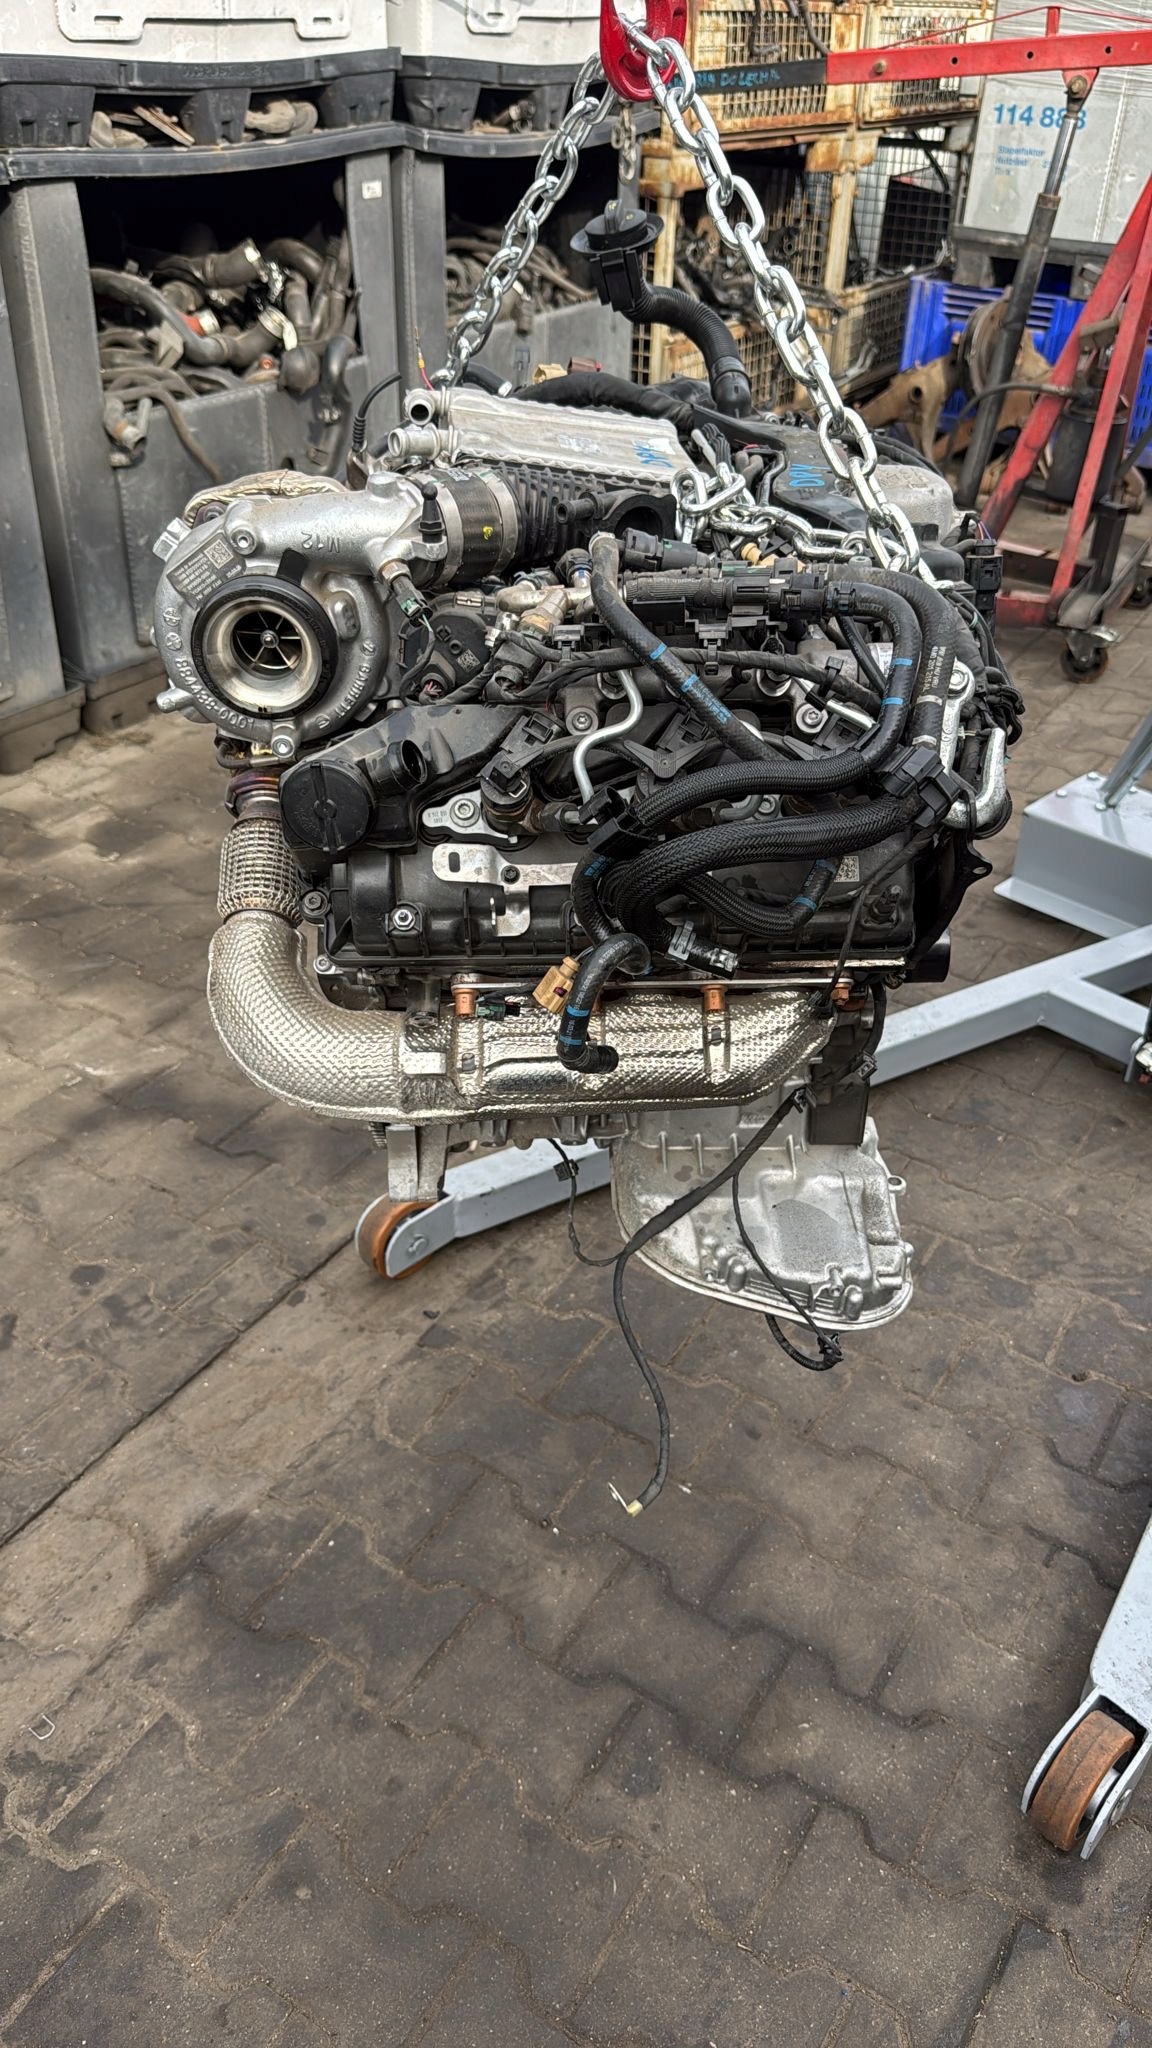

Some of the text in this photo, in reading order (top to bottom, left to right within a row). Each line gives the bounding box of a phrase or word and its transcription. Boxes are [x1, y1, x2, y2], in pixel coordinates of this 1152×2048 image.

[994, 103, 1033, 127] 114
[301, 531, 341, 554] M12
[334, 663, 372, 719] GARRETT
